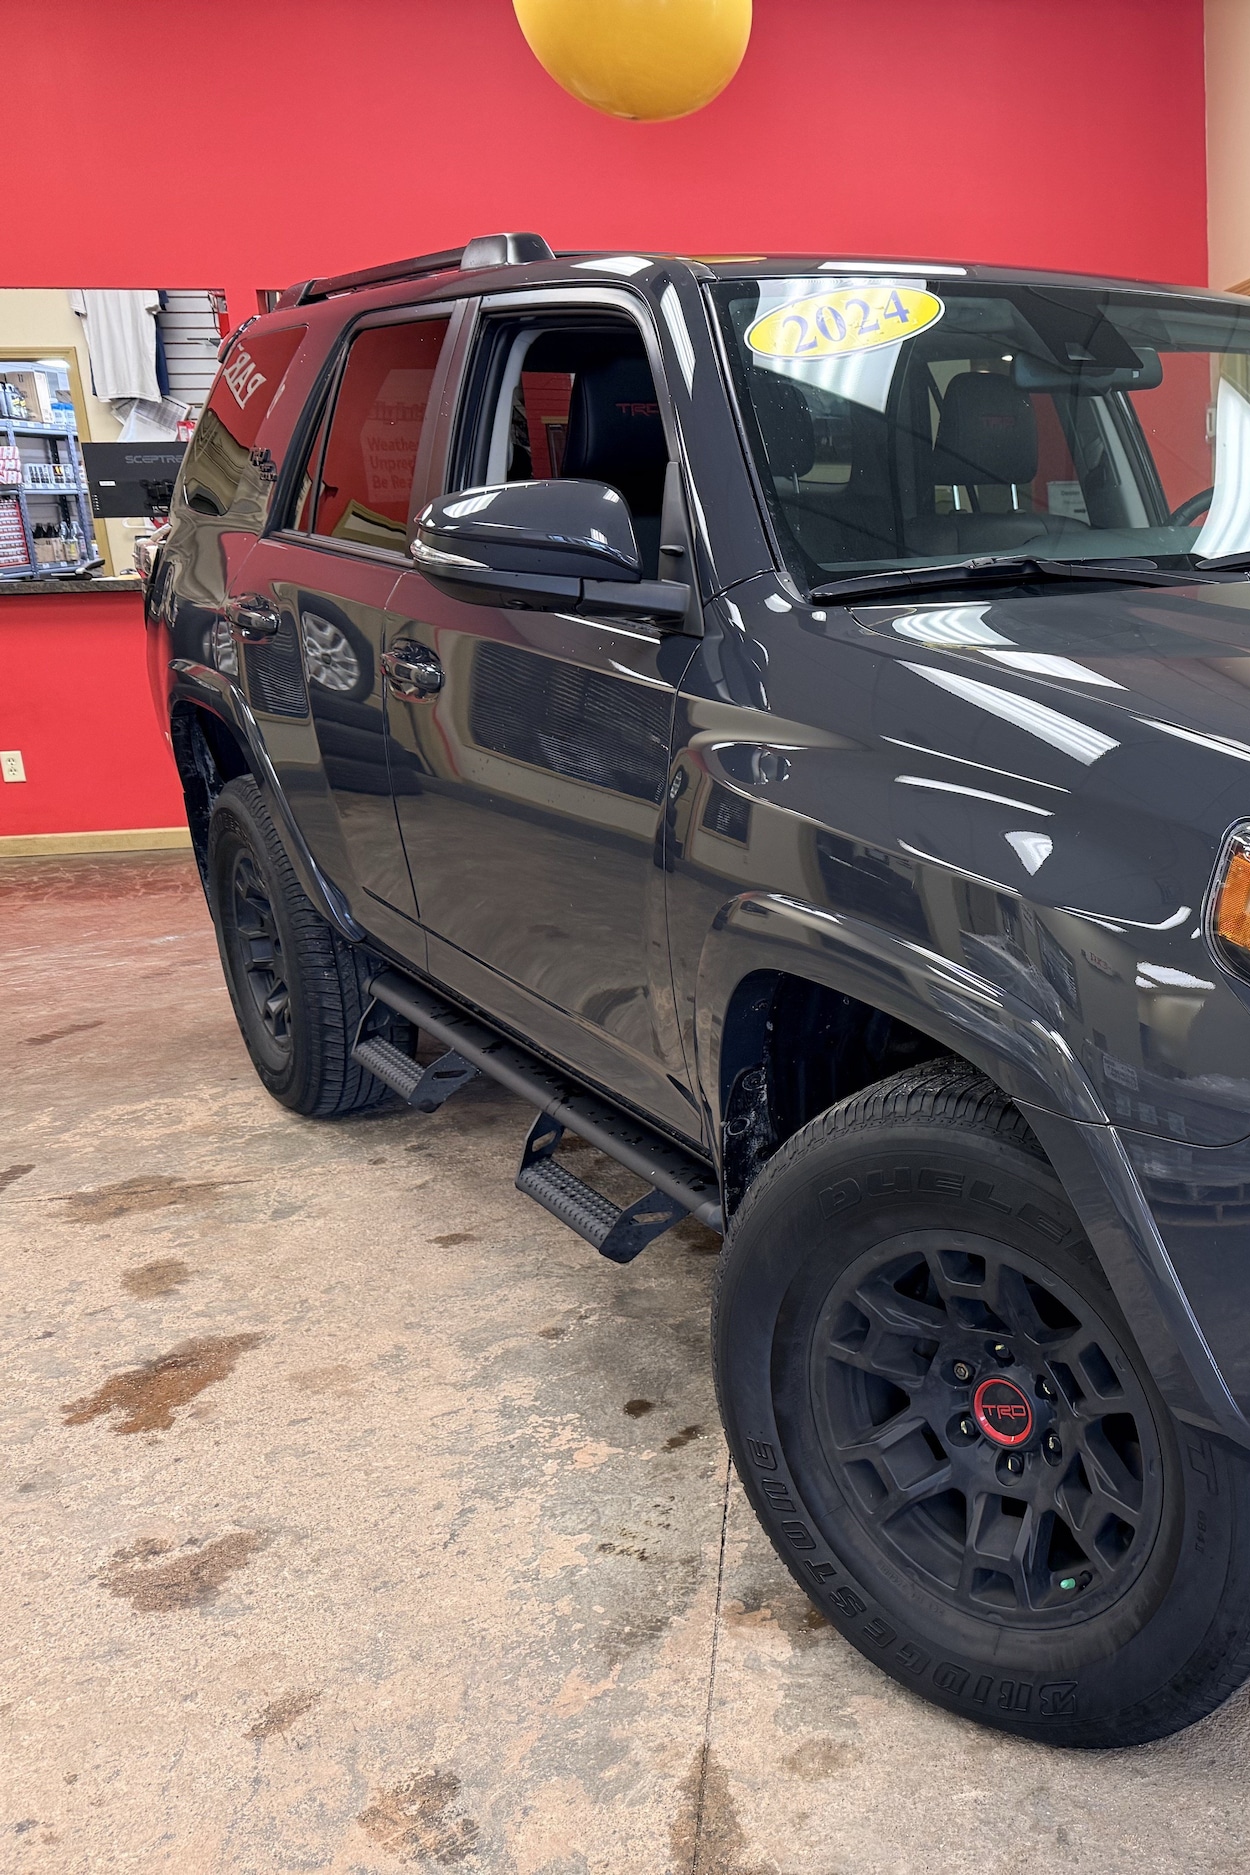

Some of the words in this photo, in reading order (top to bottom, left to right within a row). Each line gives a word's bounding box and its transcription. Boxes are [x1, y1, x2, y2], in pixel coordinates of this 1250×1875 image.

[783, 290, 910, 354] 2024
[367, 436, 418, 452] Weathe
[125, 455, 183, 464] SCEPTRE
[982, 1405, 1026, 1419] TRD
[746, 1434, 1079, 1716] BRIDGESTONE
